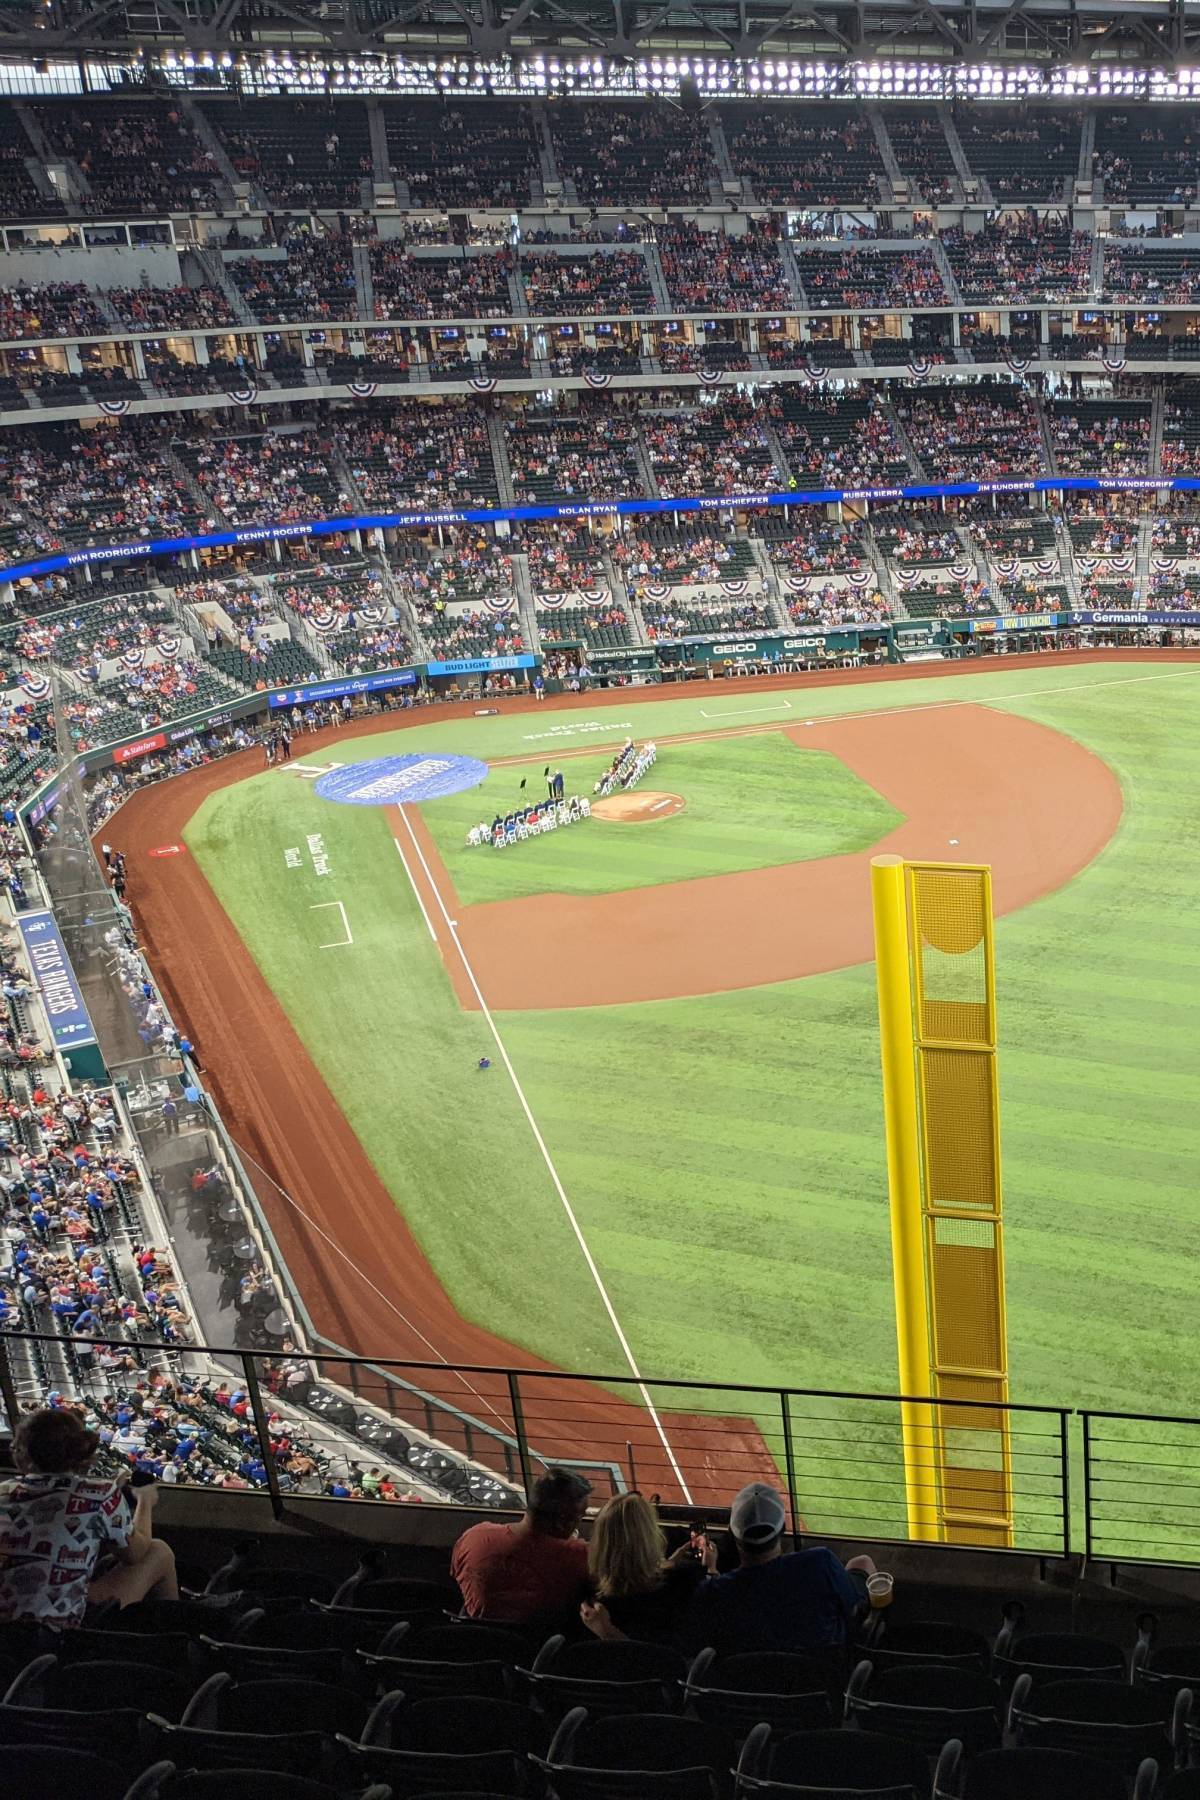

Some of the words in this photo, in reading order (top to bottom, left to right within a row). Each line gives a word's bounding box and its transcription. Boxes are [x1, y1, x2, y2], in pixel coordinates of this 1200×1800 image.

[976, 484, 991, 493] JIM
[992, 482, 1035, 491] SUNDBERG
[1098, 480, 1116, 489] TOM
[1117, 480, 1175, 489] VANDERGRIFF
[842, 491, 872, 500] RUBEN
[873, 489, 904, 498] SIERRA
[699, 499, 718, 508] TOM
[720, 496, 769, 506] SCHIEFFER
[558, 506, 590, 516] NOLAN
[592, 504, 618, 514] RYAN
[399, 515, 423, 525] JEFF
[424, 513, 468, 523] RUSSELL
[236, 531, 271, 543] KENNY
[272, 526, 313, 537] ROGERS
[68, 552, 88, 565] IVÁN
[89, 545, 152, 560] RODRÍGUEZ
[1002, 617, 1018, 629] HOW
[1018, 617, 1028, 628] TO
[1092, 612, 1148, 623] Germania
[712, 642, 757, 655] GEICO
[783, 637, 827, 649] GEICO
[465, 661, 490, 670] LIGHT
[157, 845, 180, 854] T
[30, 939, 64, 971] TEXAS
[39, 968, 79, 1015] RANGERS
[71, 1498, 86, 1512] T
